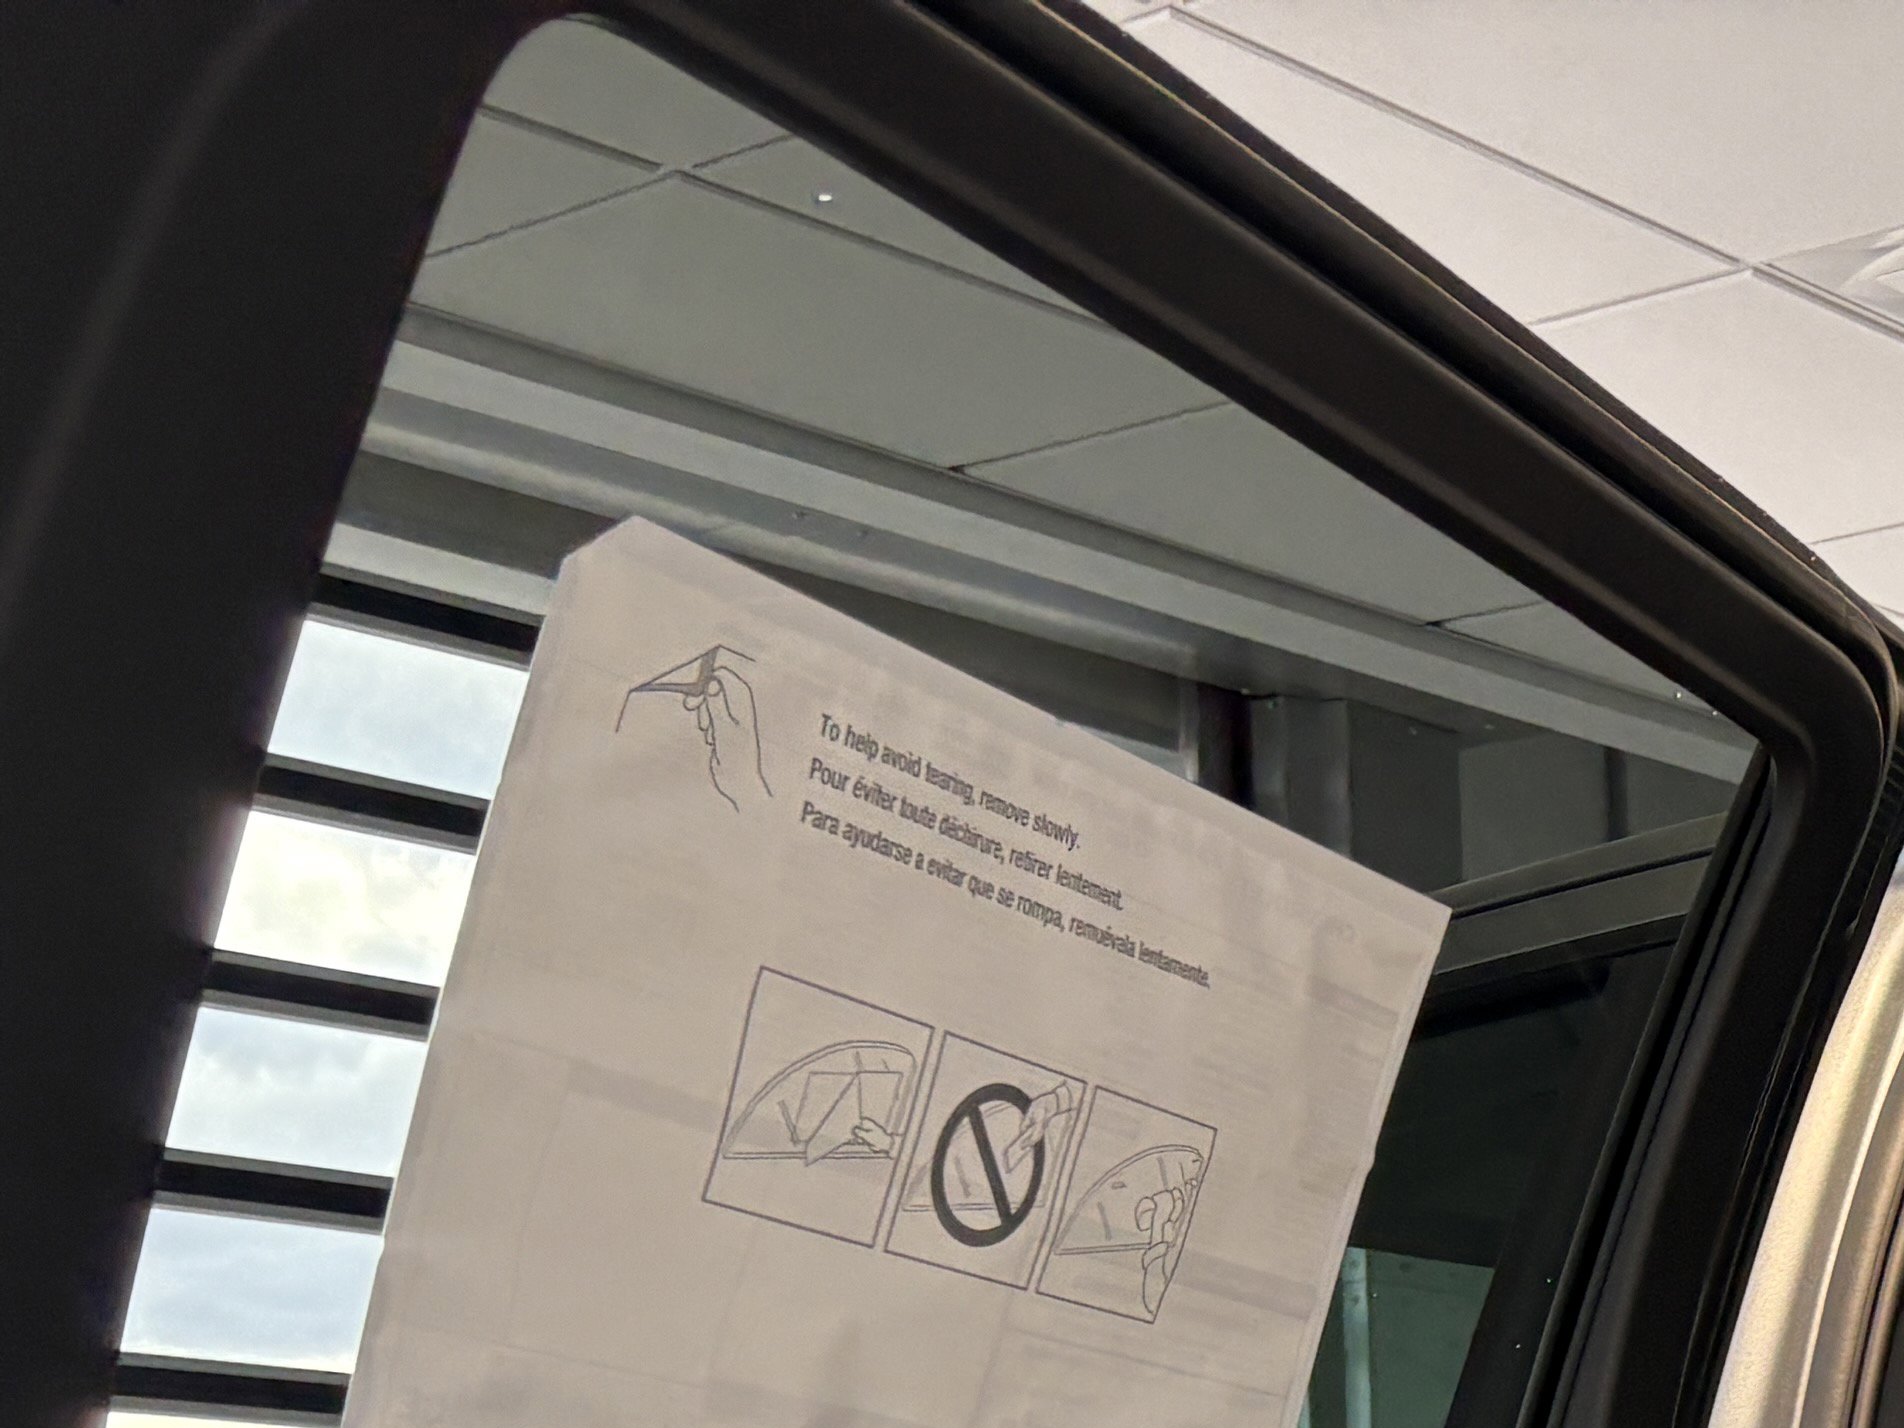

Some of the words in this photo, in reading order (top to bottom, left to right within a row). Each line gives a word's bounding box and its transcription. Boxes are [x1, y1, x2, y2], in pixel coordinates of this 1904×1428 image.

[809, 757, 851, 792] Pour
[852, 775, 898, 813] éviter
[900, 796, 937, 830] toute
[938, 814, 1004, 866] déchirure,
[1008, 848, 1053, 881] retirer
[821, 713, 840, 742] To
[844, 724, 879, 762] help
[881, 745, 922, 778] avoid
[925, 762, 976, 806] tearing,
[979, 790, 1031, 827] remove
[1032, 813, 1080, 851] slowly.
[801, 800, 840, 836] Para
[842, 822, 913, 866] ayudarse
[914, 852, 925, 871] a
[926, 858, 967, 888] evitar
[968, 874, 995, 898] que
[996, 886, 1015, 909] se
[1016, 895, 1065, 933] rompa,
[1068, 916, 1136, 958] remuévala
